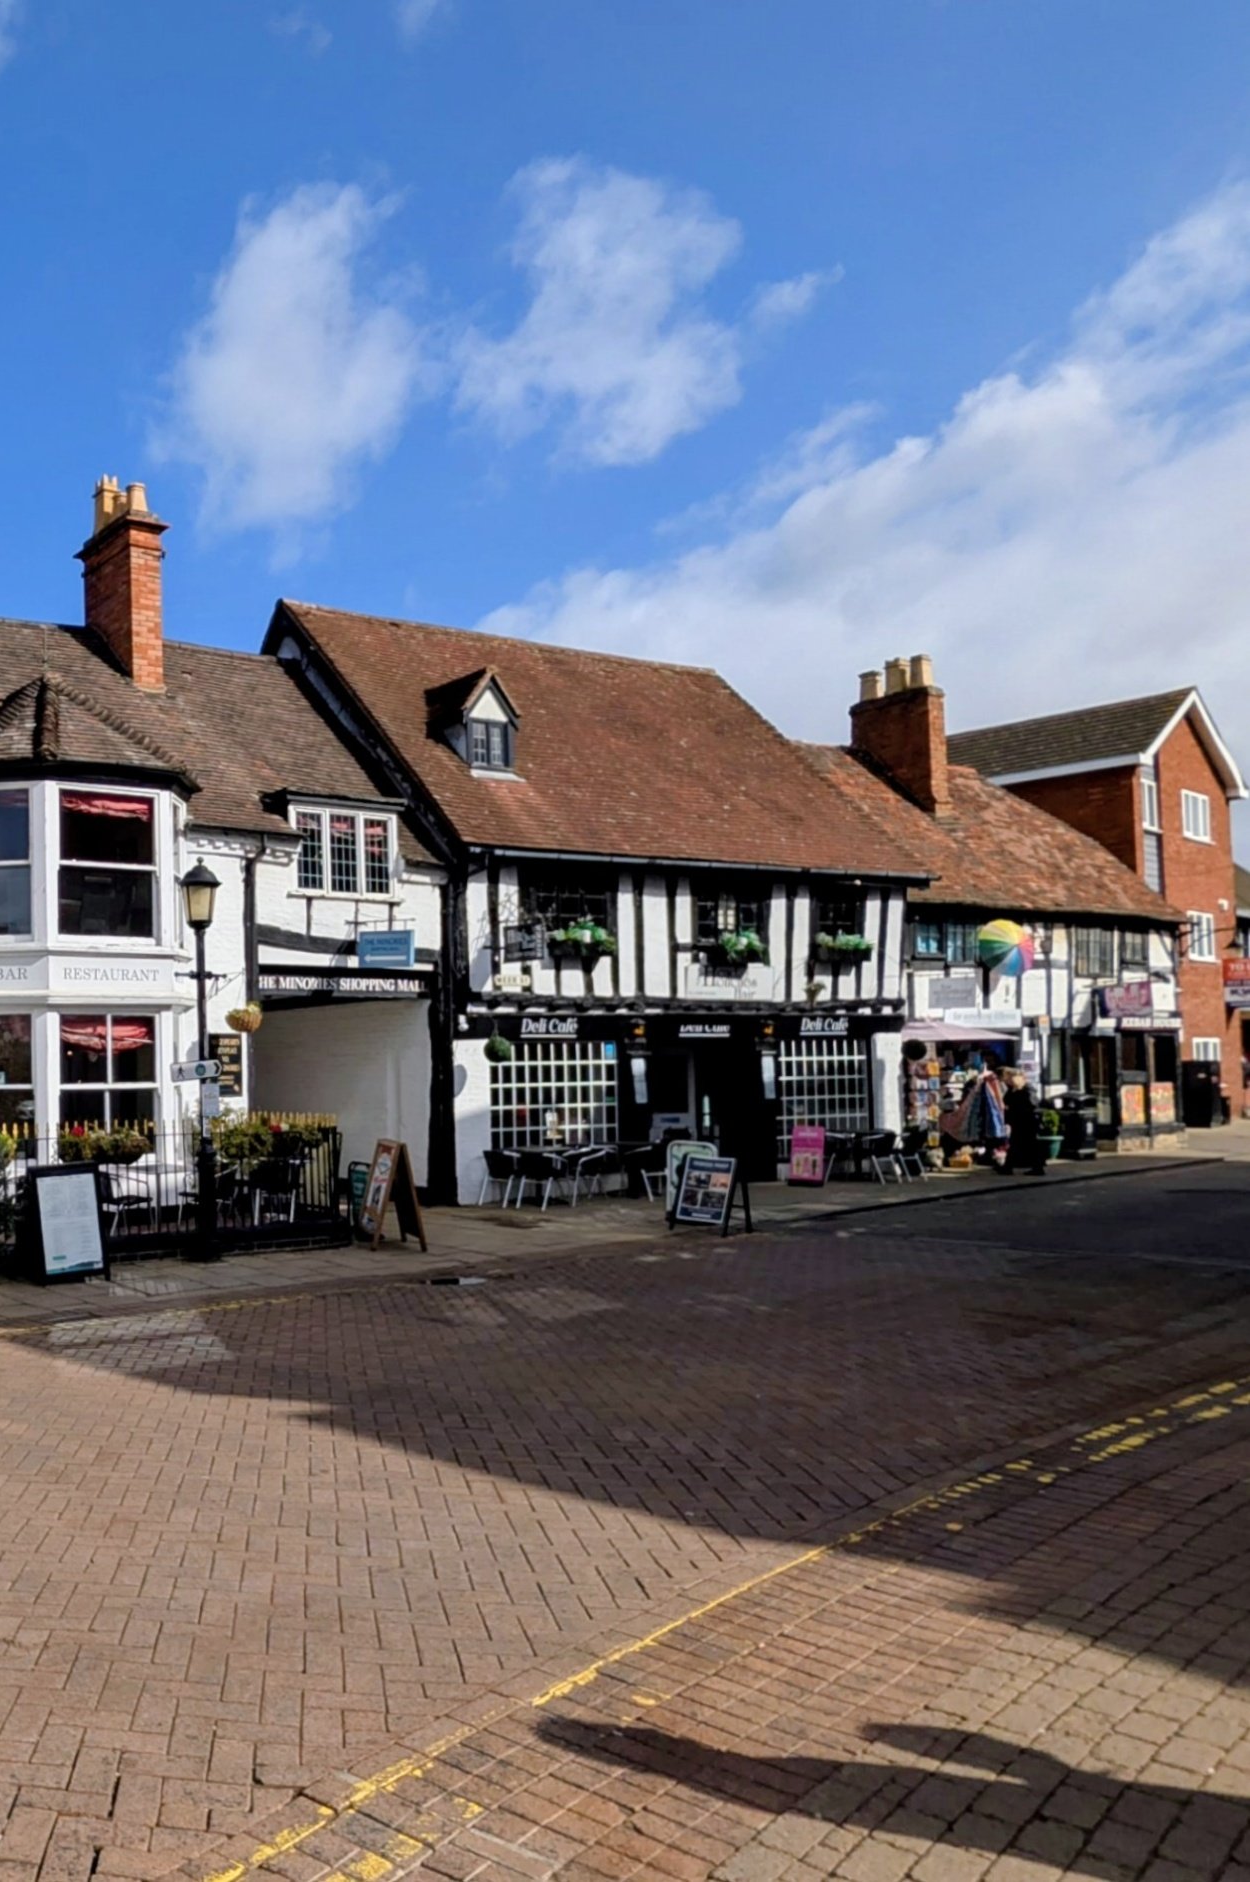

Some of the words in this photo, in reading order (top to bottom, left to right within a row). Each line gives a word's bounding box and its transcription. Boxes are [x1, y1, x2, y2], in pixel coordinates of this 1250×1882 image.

[63, 968, 160, 982] RESTAURANT
[257, 976, 276, 989] HE
[279, 976, 338, 990] MINORIES
[339, 978, 395, 991] SHOPPING
[521, 1018, 547, 1033] Deli
[548, 1017, 578, 1033] Café
[801, 1018, 823, 1032] Deli
[824, 1017, 849, 1031] Café
